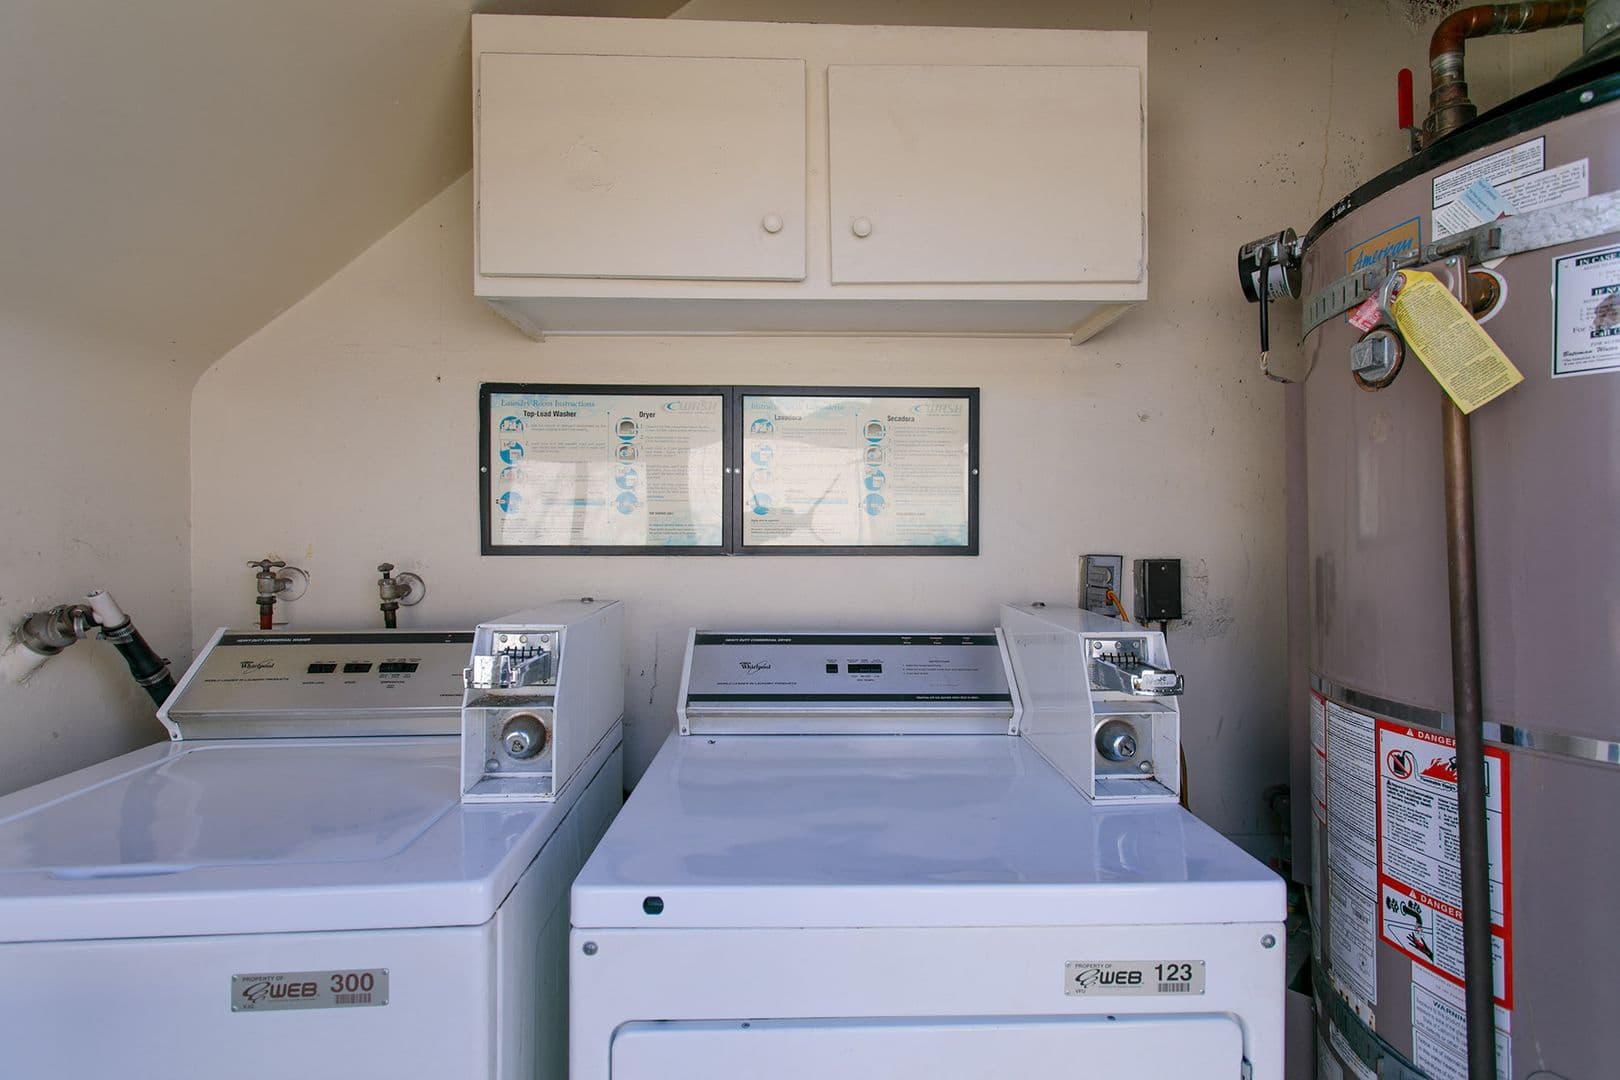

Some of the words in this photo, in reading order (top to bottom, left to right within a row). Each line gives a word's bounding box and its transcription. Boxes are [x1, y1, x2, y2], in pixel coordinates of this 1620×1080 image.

[1351, 239, 1414, 273] American
[1591, 253, 1617, 264] CASE
[501, 399, 530, 409] Laundry
[533, 400, 553, 408] Room
[554, 400, 596, 408] Instructions
[523, 410, 552, 418] Top-Load
[553, 410, 577, 418] Washer
[639, 411, 656, 419] Dryer
[240, 660, 275, 674] Whirlpool
[739, 661, 772, 674] Whirlpool
[1420, 895, 1463, 919] DANGER
[1100, 971, 1143, 984] WEB
[1154, 963, 1193, 982] 123
[330, 972, 374, 993] 300
[269, 982, 317, 999] WEB
[1432, 1001, 1466, 1023] WARNIN
